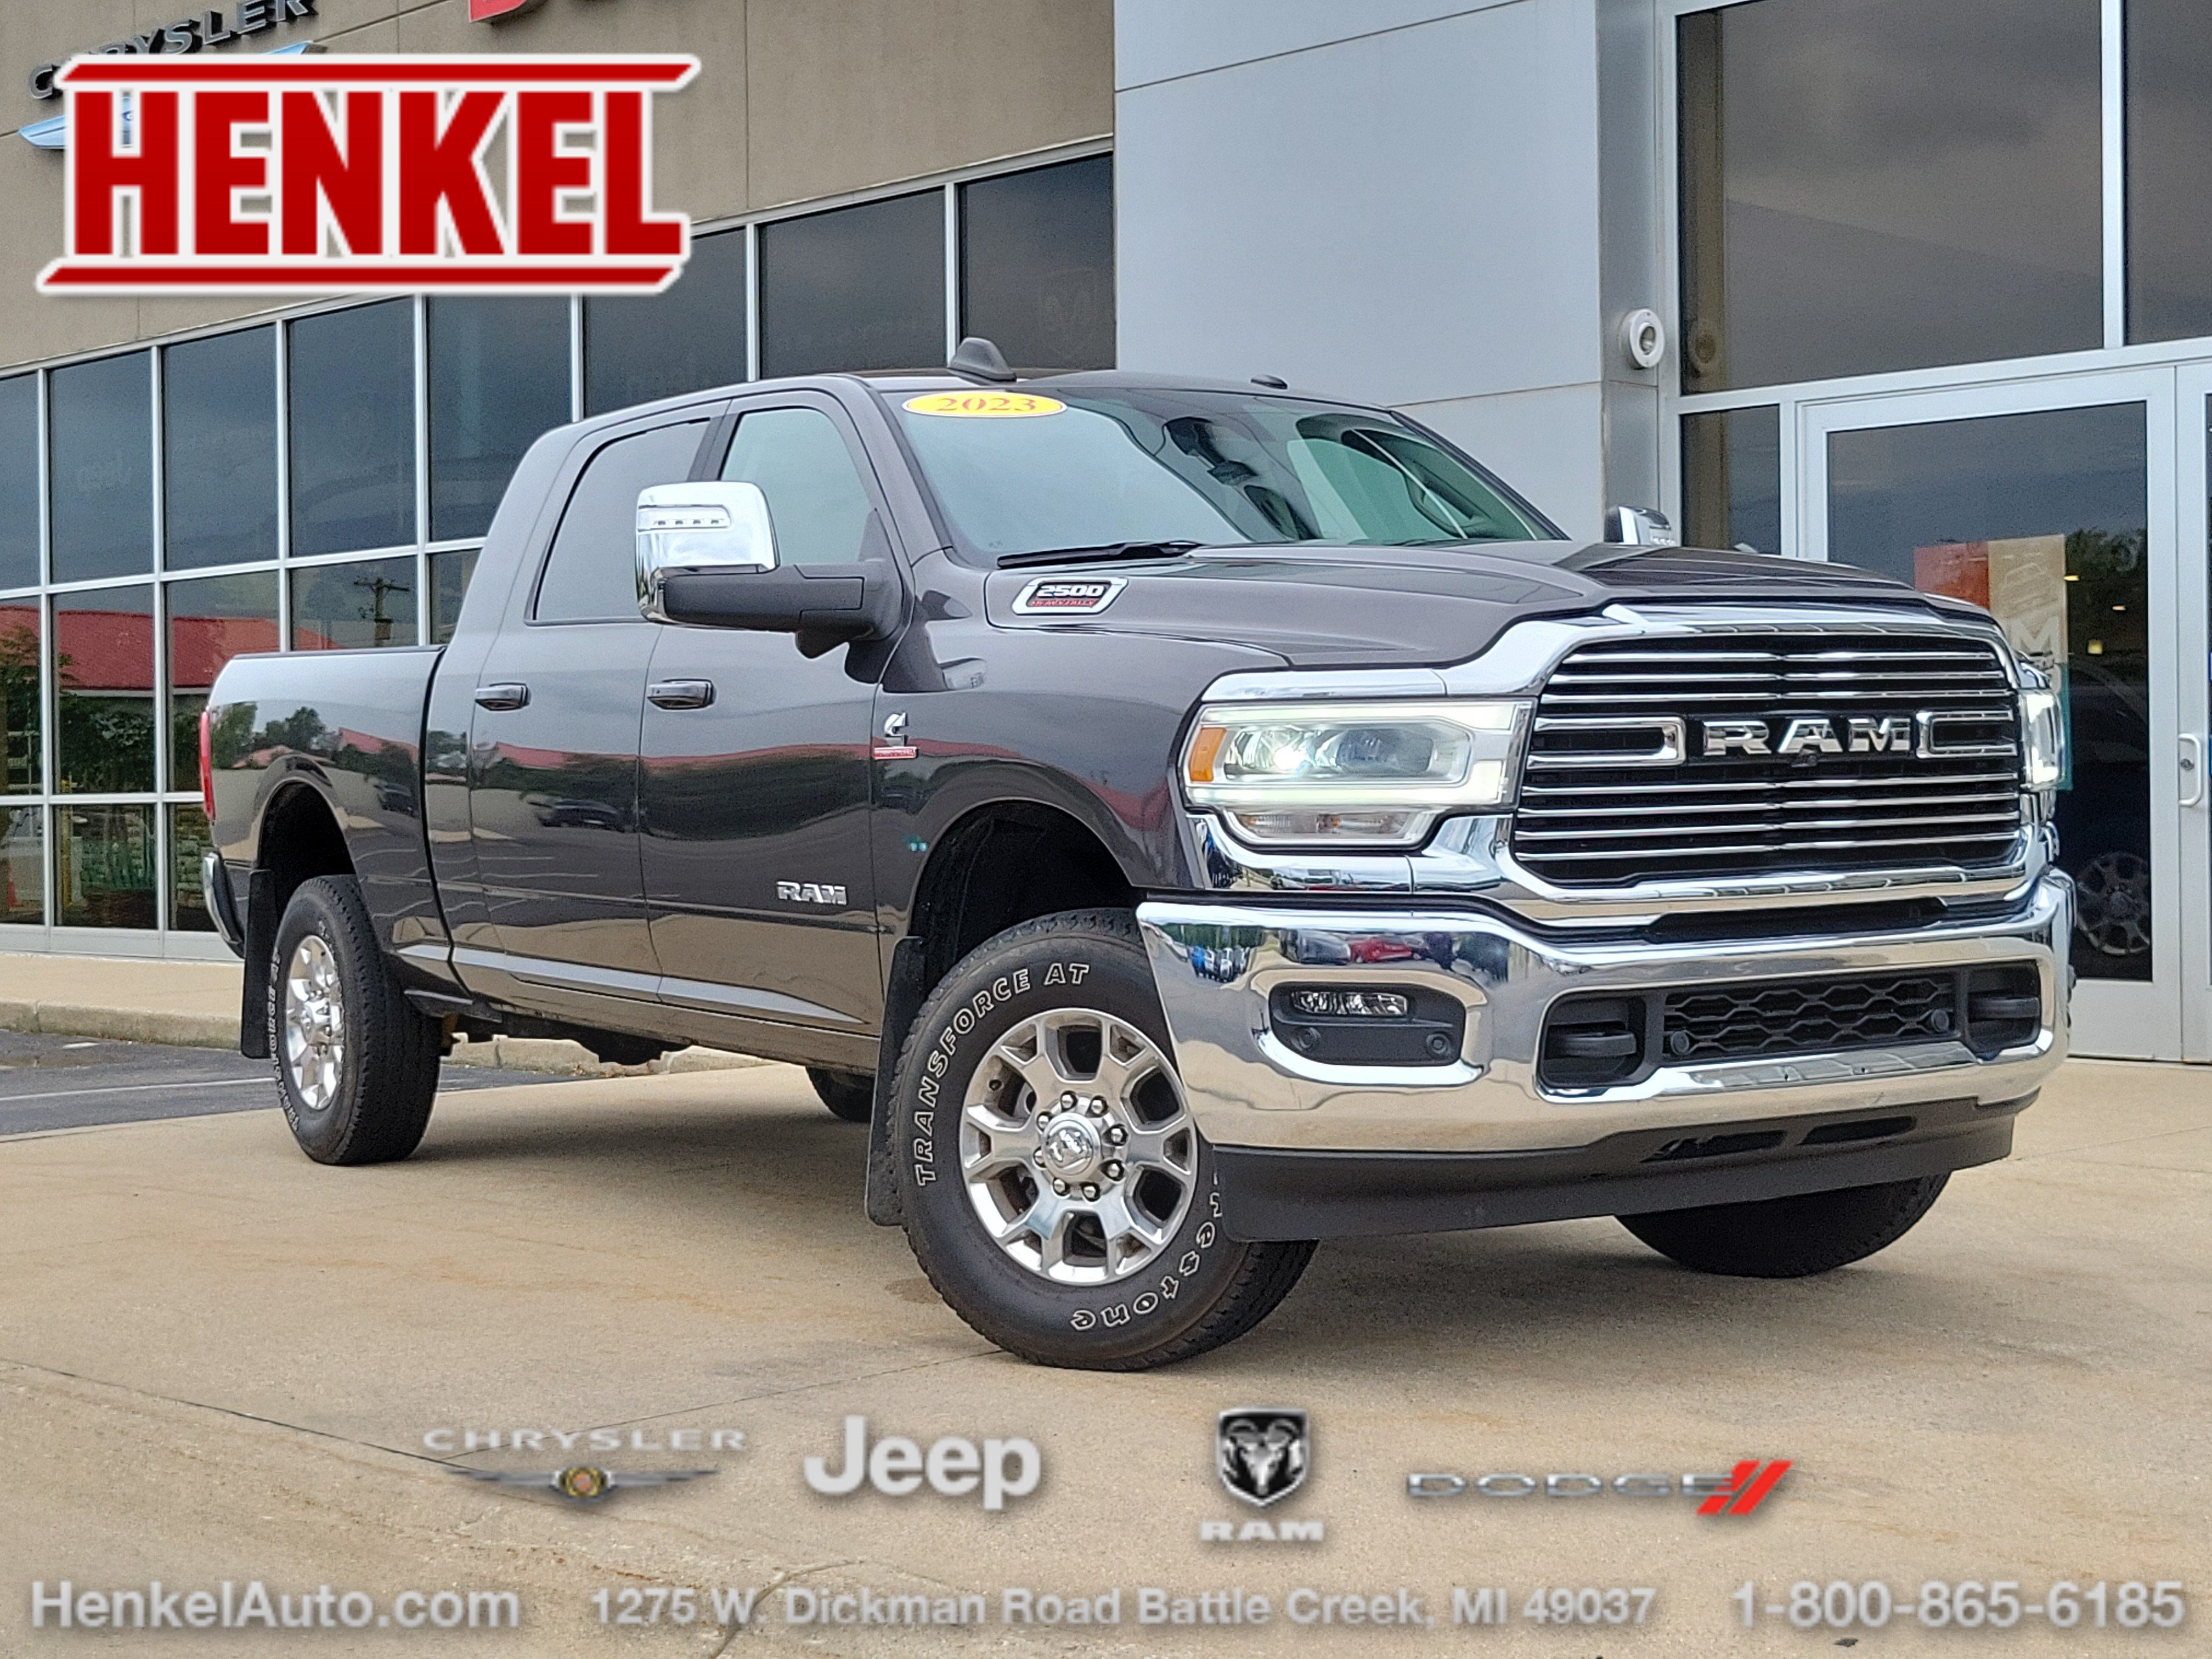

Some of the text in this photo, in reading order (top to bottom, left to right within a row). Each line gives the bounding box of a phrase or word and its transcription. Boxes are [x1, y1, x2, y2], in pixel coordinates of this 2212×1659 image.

[29, 0, 312, 99] CYSLER
[935, 398, 1037, 412] 2023
[1036, 585, 1105, 597] 2500
[1703, 718, 1910, 756] RAM
[776, 881, 848, 906] RAM
[915, 963, 1089, 1188] TRANSFORCE AT
